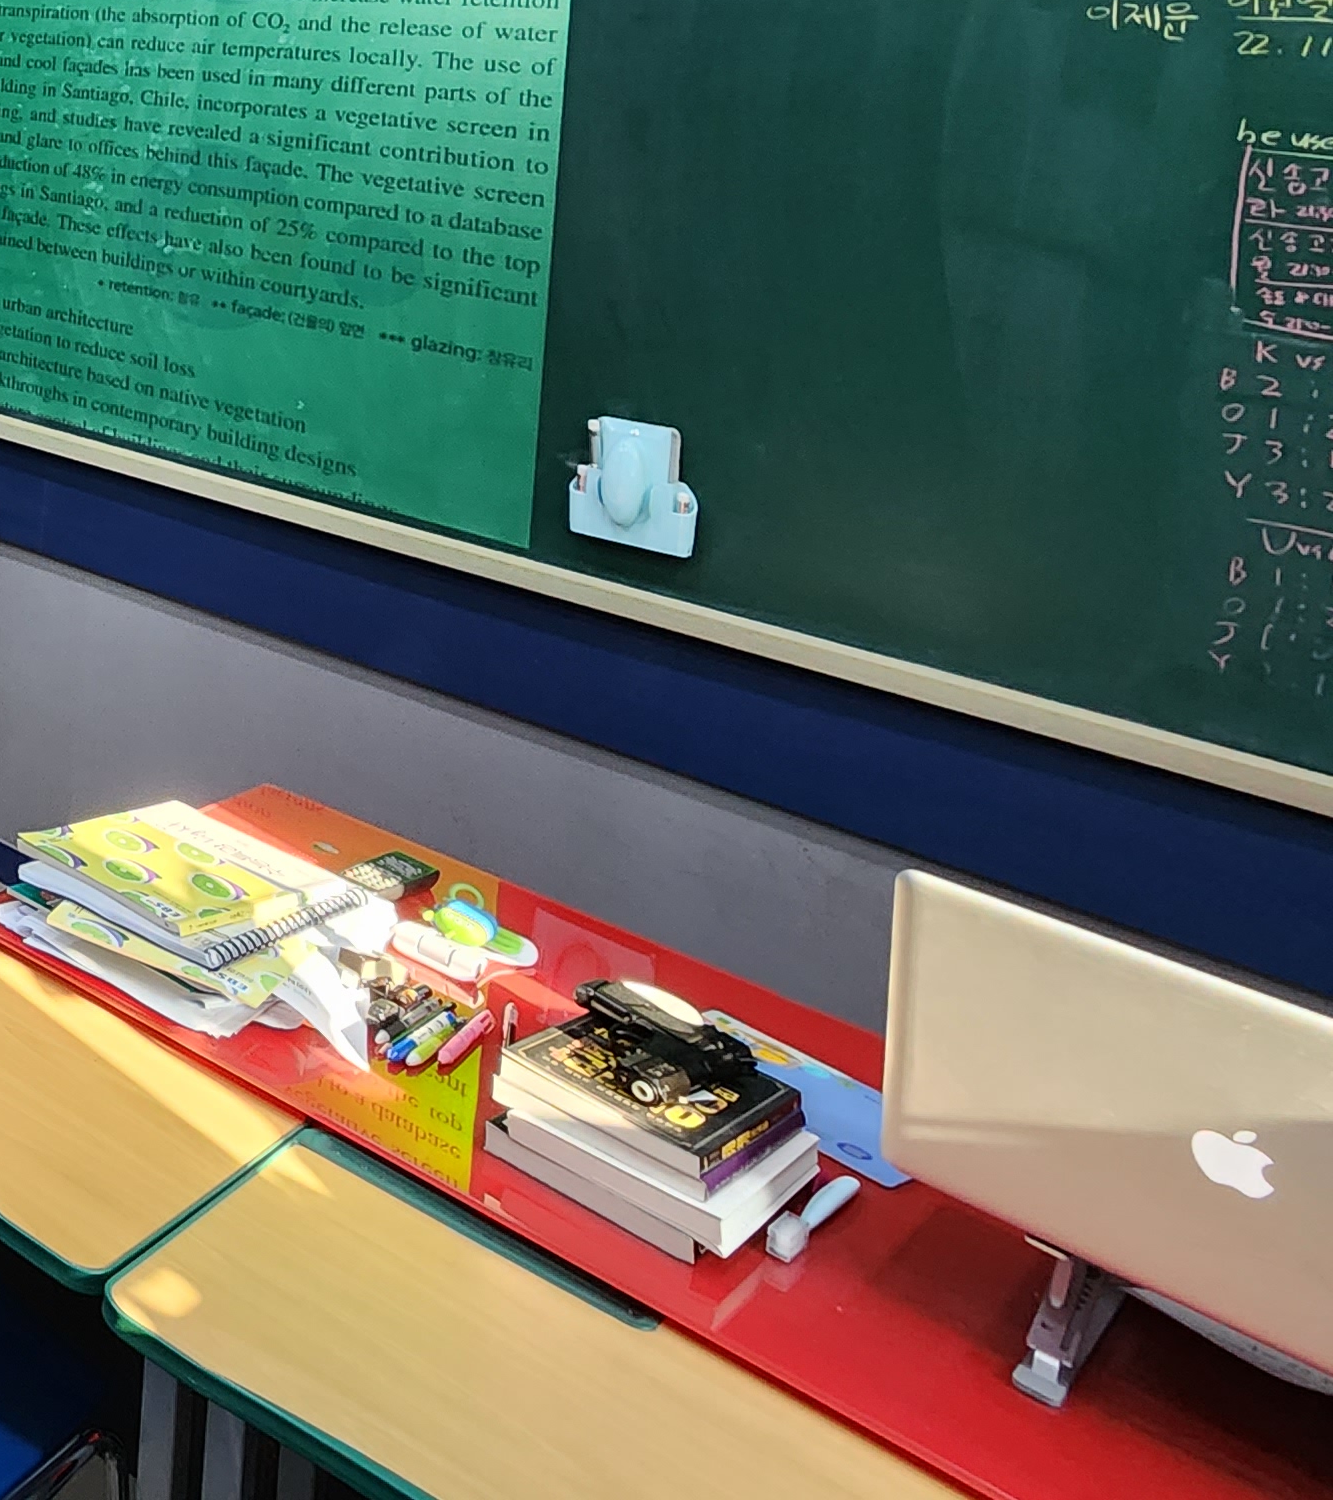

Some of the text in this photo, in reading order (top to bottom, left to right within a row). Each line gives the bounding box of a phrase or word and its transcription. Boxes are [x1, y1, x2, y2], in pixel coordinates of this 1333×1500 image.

[96, 7, 125, 23] (the
[133, 8, 219, 29] absorption
[227, 12, 247, 27] of
[298, 16, 331, 32] and
[342, 18, 370, 33] the
[380, 19, 452, 37] release
[462, 22, 487, 39] of
[495, 26, 558, 43] water
[10, 32, 91, 48] vegetation)
[98, 37, 124, 49] can
[132, 37, 183, 53] reduce
[192, 40, 215, 54] air
[222, 43, 340, 62] temperatures
[349, 47, 422, 71] locally.
[432, 51, 473, 71] The
[485, 58, 520, 73] use
[531, 57, 557, 75] of
[26, 56, 56, 70] cool
[125, 60, 150, 77] has
[157, 64, 194, 81] been
[202, 68, 241, 84] used
[249, 70, 265, 86] in
[273, 74, 323, 94] many
[331, 76, 415, 97] different
[425, 84, 475, 103] parts
[486, 87, 511, 104] of
[519, 90, 552, 108] the
[1236, 117, 1281, 146] be
[3, 298, 41, 316] urban
[46, 307, 133, 336] architecture
[73, 386, 87, 408] in
[91, 399, 201, 441] contemporary
[206, 421, 279, 461] building
[285, 446, 357, 478] designs
